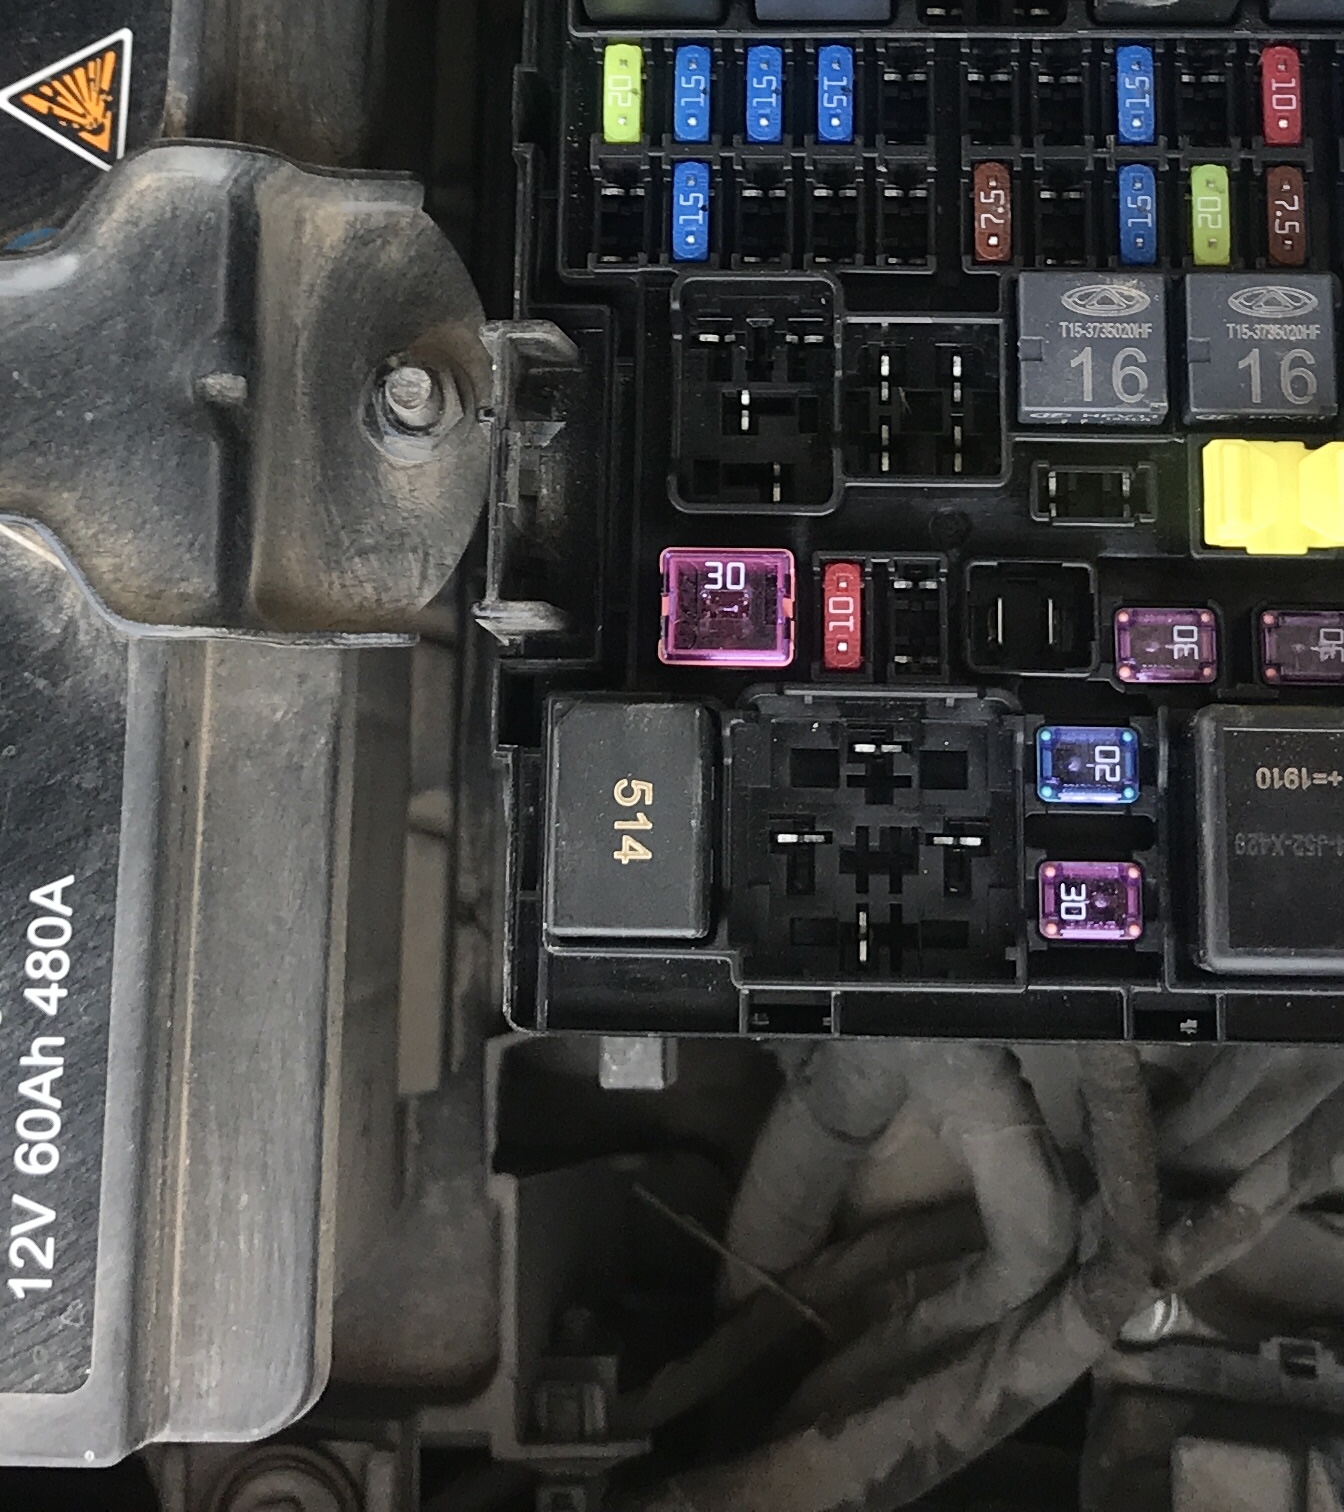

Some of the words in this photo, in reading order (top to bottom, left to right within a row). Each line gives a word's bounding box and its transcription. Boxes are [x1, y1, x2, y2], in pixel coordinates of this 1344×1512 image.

[608, 74, 632, 107] 20
[681, 74, 705, 107] 15
[752, 74, 777, 107] 15
[823, 75, 847, 108] 15
[1125, 76, 1150, 108] 15
[1270, 78, 1297, 110] 10
[679, 192, 704, 225] 15
[980, 189, 1005, 230] 7.5
[1127, 195, 1152, 228] 15
[1197, 196, 1222, 229] 20
[1274, 195, 1300, 235] 7.5
[1070, 346, 1149, 405] 16
[1237, 348, 1317, 406] 16
[705, 561, 746, 590] 30
[828, 596, 854, 631] 10
[1173, 625, 1199, 659] 30
[1317, 628, 1344, 661] 30
[613, 778, 653, 865] 514
[1060, 882, 1086, 921] 30
[24, 874, 76, 1017] 480A
[14, 1035, 65, 1176] 60Ah
[8, 1193, 56, 1299] 12V
